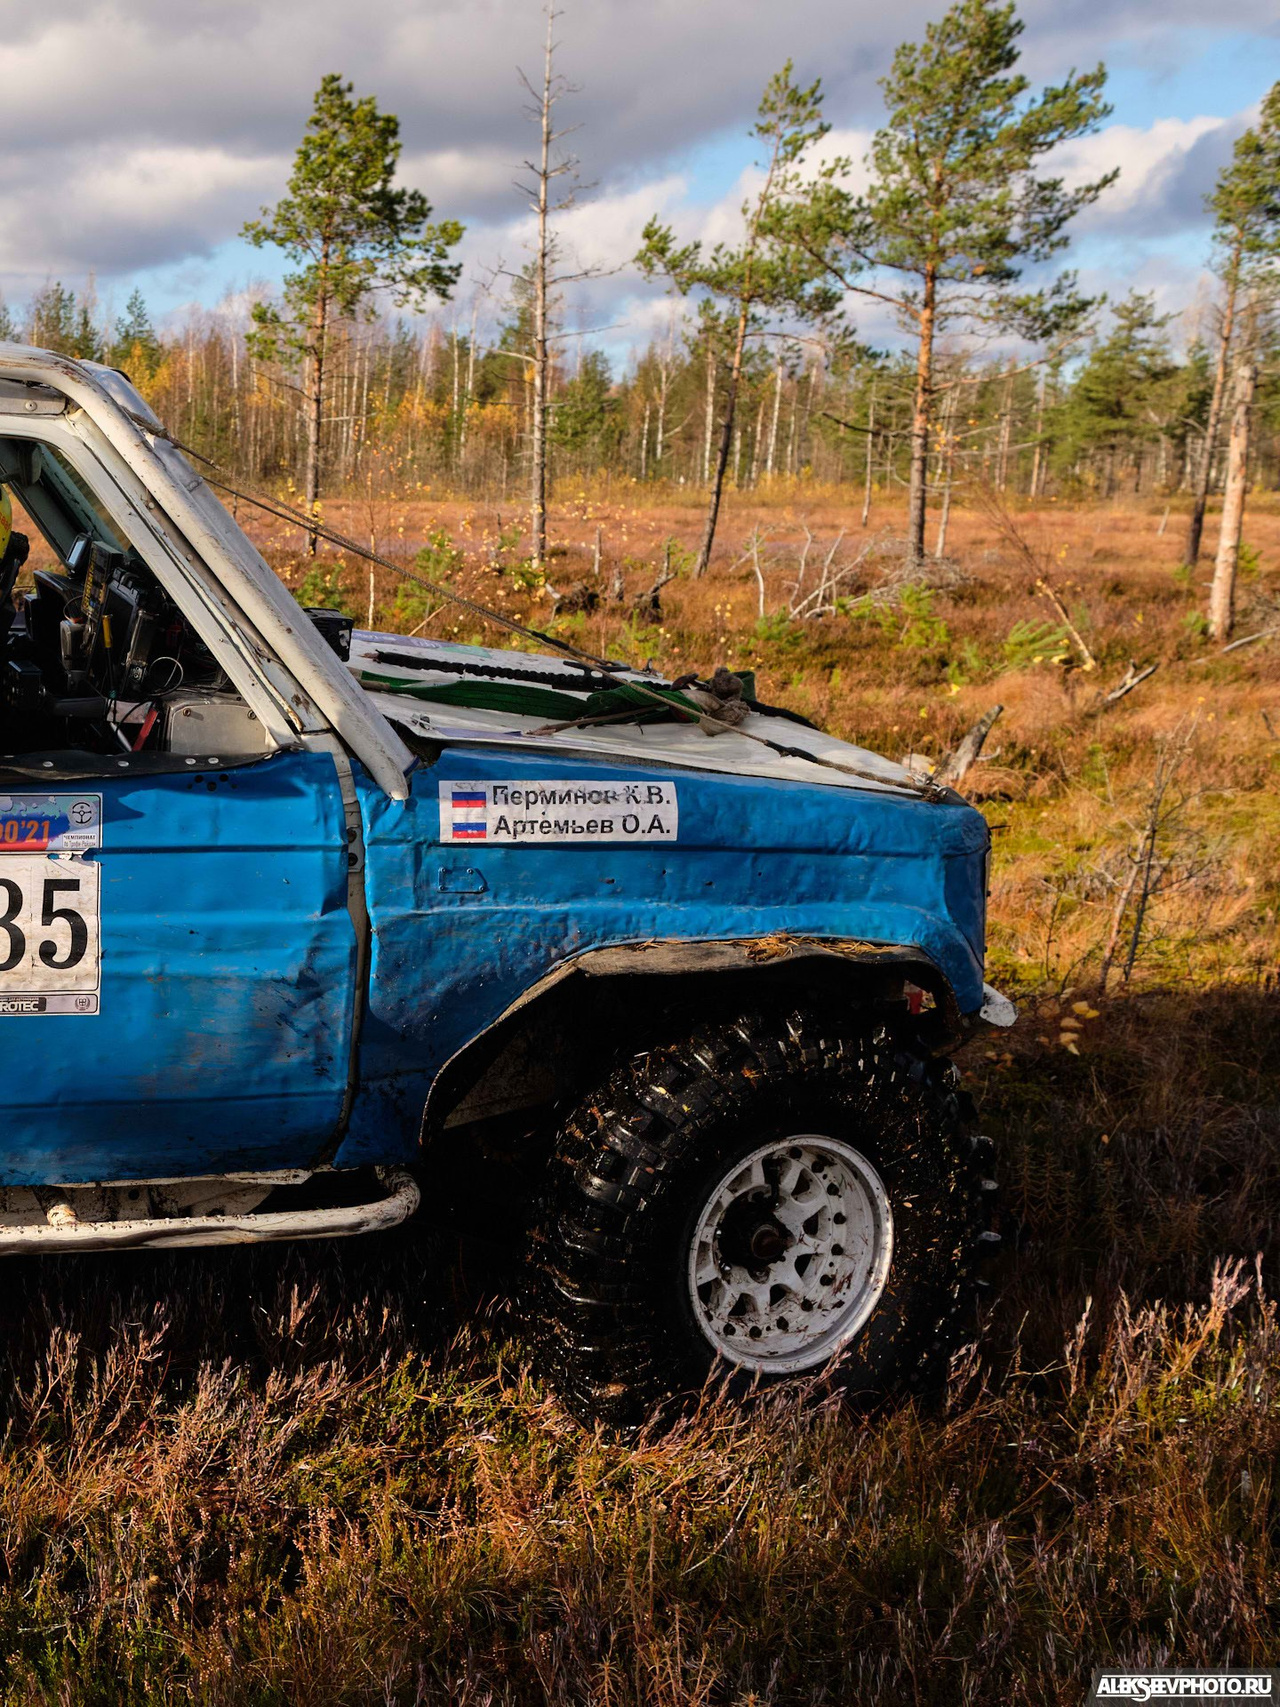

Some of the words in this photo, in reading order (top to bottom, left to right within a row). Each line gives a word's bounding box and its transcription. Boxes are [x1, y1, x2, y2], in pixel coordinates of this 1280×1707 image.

[492, 785, 619, 810] Перминов
[625, 785, 671, 805] К.В.
[494, 815, 614, 839] Артемьев
[622, 814, 671, 834] О.А.
